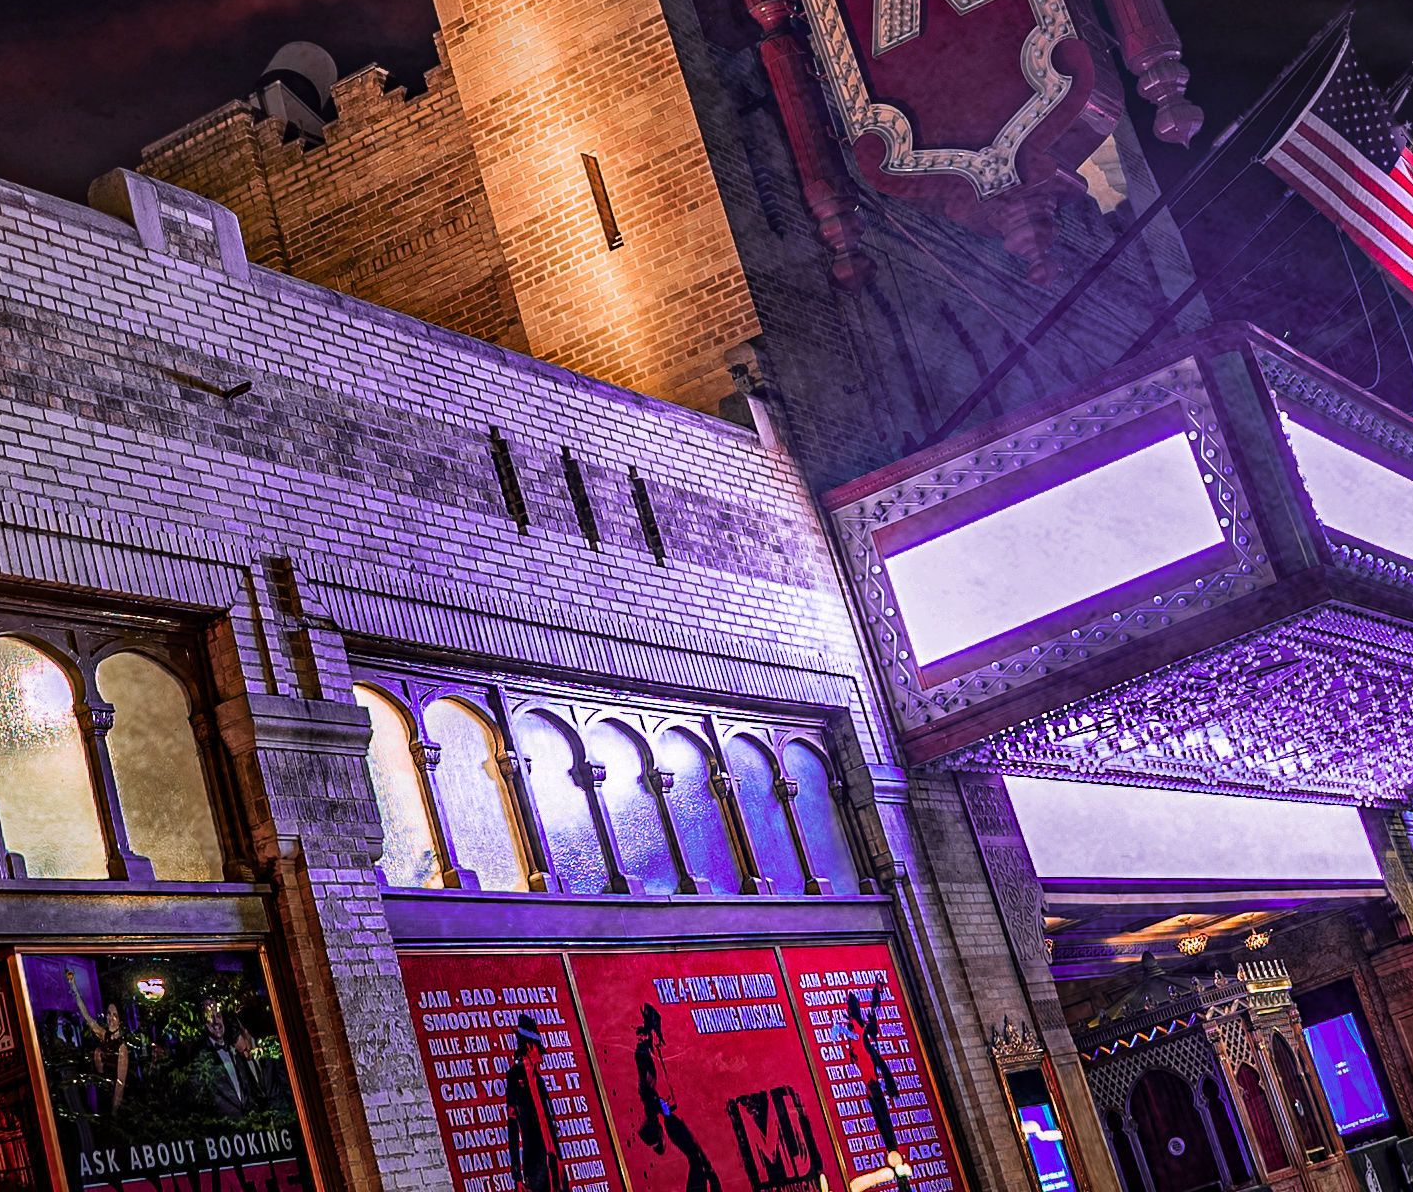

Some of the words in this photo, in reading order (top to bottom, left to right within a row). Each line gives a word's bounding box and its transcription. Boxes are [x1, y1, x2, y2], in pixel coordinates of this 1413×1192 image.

[652, 978, 680, 1004] THE
[678, 976, 716, 1003] 4-TIME
[711, 974, 742, 1000] TONY
[740, 973, 777, 999] AWARD
[799, 973, 822, 989] JAM
[824, 971, 850, 987] BAD
[417, 991, 452, 1009] JAM
[460, 989, 496, 1006] BAD
[502, 986, 558, 1005] MONEY
[803, 989, 848, 1007] SMOOTH
[422, 1010, 492, 1032] SMOOTH
[690, 1007, 741, 1034] WINNING
[736, 1003, 787, 1030] MUSICAL!
[428, 1036, 463, 1057] BILLIE
[464, 1034, 491, 1054] JEAN
[499, 1033, 506, 1051] I
[548, 1030, 572, 1048] BACK
[898, 1038, 910, 1054] IT
[819, 1044, 846, 1062] CAN
[434, 1058, 476, 1079] BLAME
[477, 1057, 490, 1076] IT
[493, 1056, 511, 1075] ON
[825, 1064, 846, 1081] THEY
[440, 1081, 478, 1102] CAN
[481, 1078, 508, 1098] YO
[565, 1072, 580, 1090] IT
[445, 1106, 476, 1127] THEY
[548, 1096, 573, 1116] OUT
[572, 1095, 588, 1113] US
[836, 1100, 861, 1117] MAN
[451, 1125, 509, 1150] DANCIN
[79, 1148, 121, 1177] ASK
[130, 1139, 197, 1171] ABOUT
[205, 1128, 293, 1161] BOOKING
[558, 1138, 601, 1160] IRROR
[909, 1141, 944, 1162] ABC
[457, 1152, 494, 1174] MAN
[571, 1159, 606, 1181] ENOUGH
[852, 1150, 886, 1172] BEAT
[908, 1159, 949, 1181] ATURE
